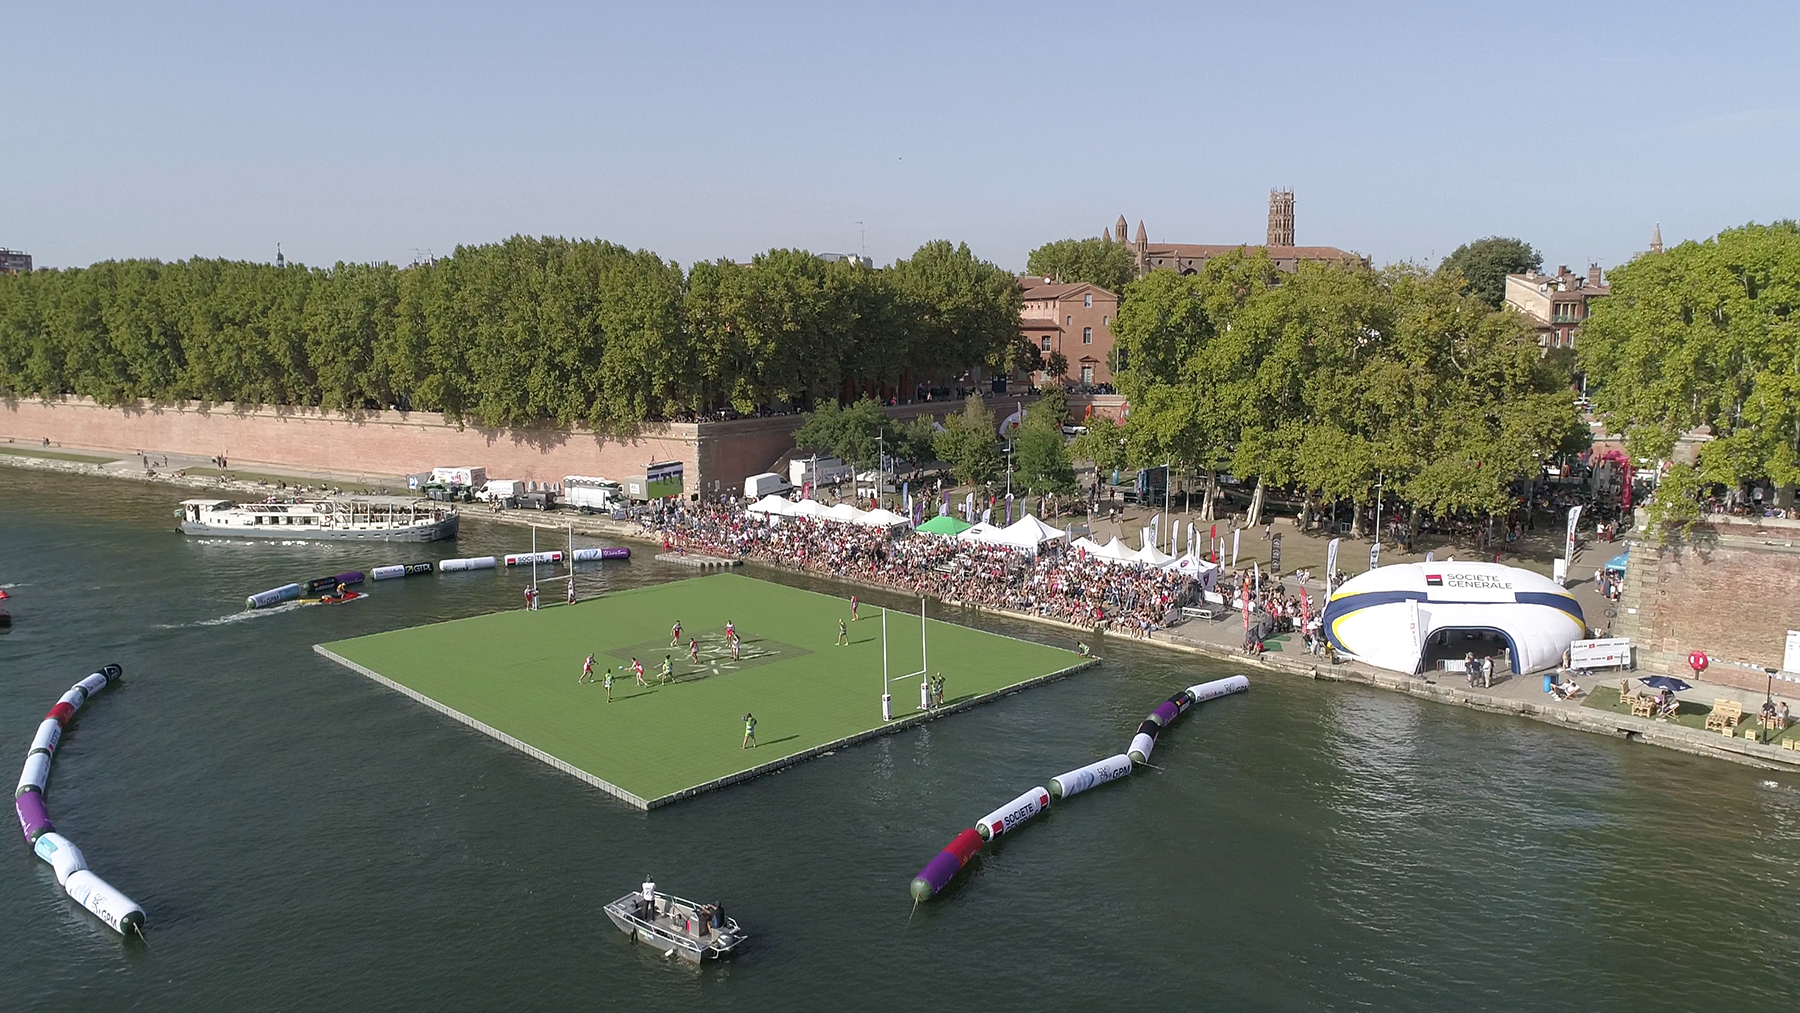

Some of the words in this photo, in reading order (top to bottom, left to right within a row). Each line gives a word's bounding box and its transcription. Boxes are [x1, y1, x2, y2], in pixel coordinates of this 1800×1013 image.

[517, 554, 545, 563] SOCITE
[1447, 573, 1500, 582] SOCIETE
[1448, 580, 1513, 590] GENERALE
[1112, 764, 1130, 778] GPM
[1004, 802, 1034, 826] SOCIETE
[101, 909, 118, 929] GPM
